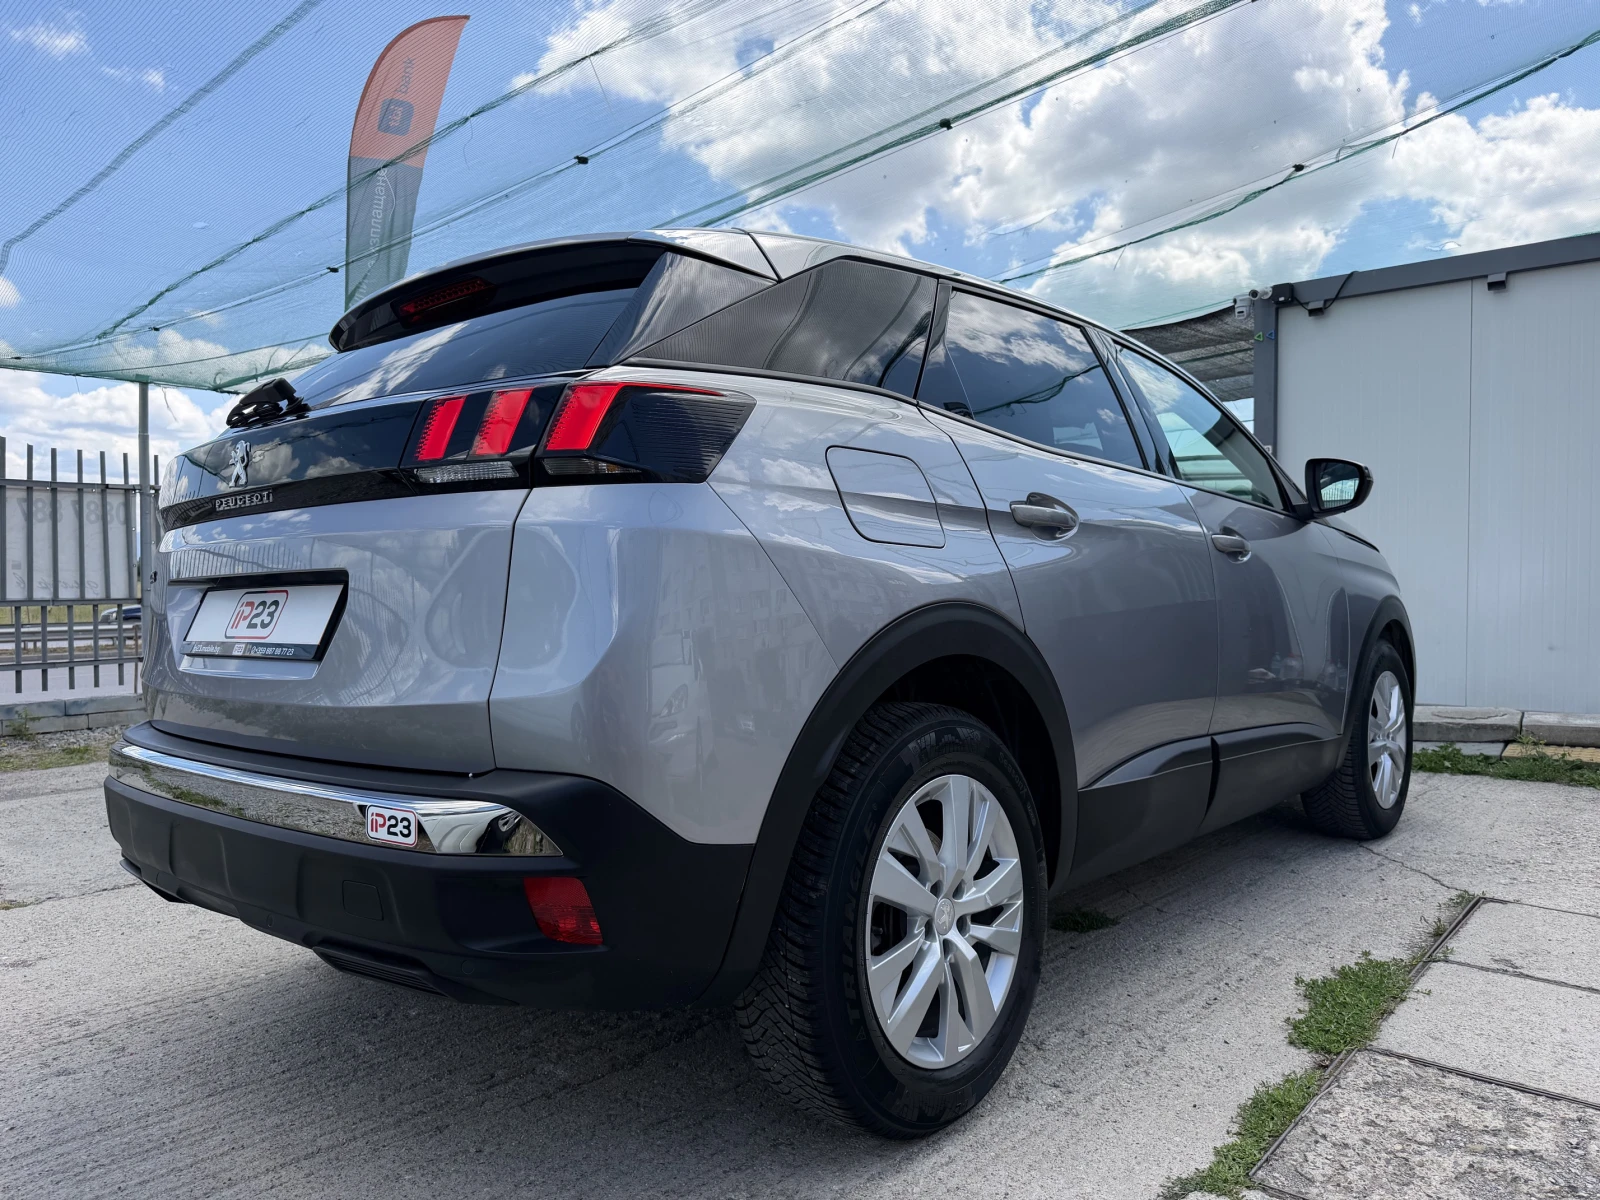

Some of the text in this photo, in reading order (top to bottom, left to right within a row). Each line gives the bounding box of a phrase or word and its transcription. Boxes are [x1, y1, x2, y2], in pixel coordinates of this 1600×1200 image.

[389, 57, 415, 127] tbi bank
[215, 491, 268, 507] PEUGEOT
[841, 814, 877, 1025] TRIANGLE
